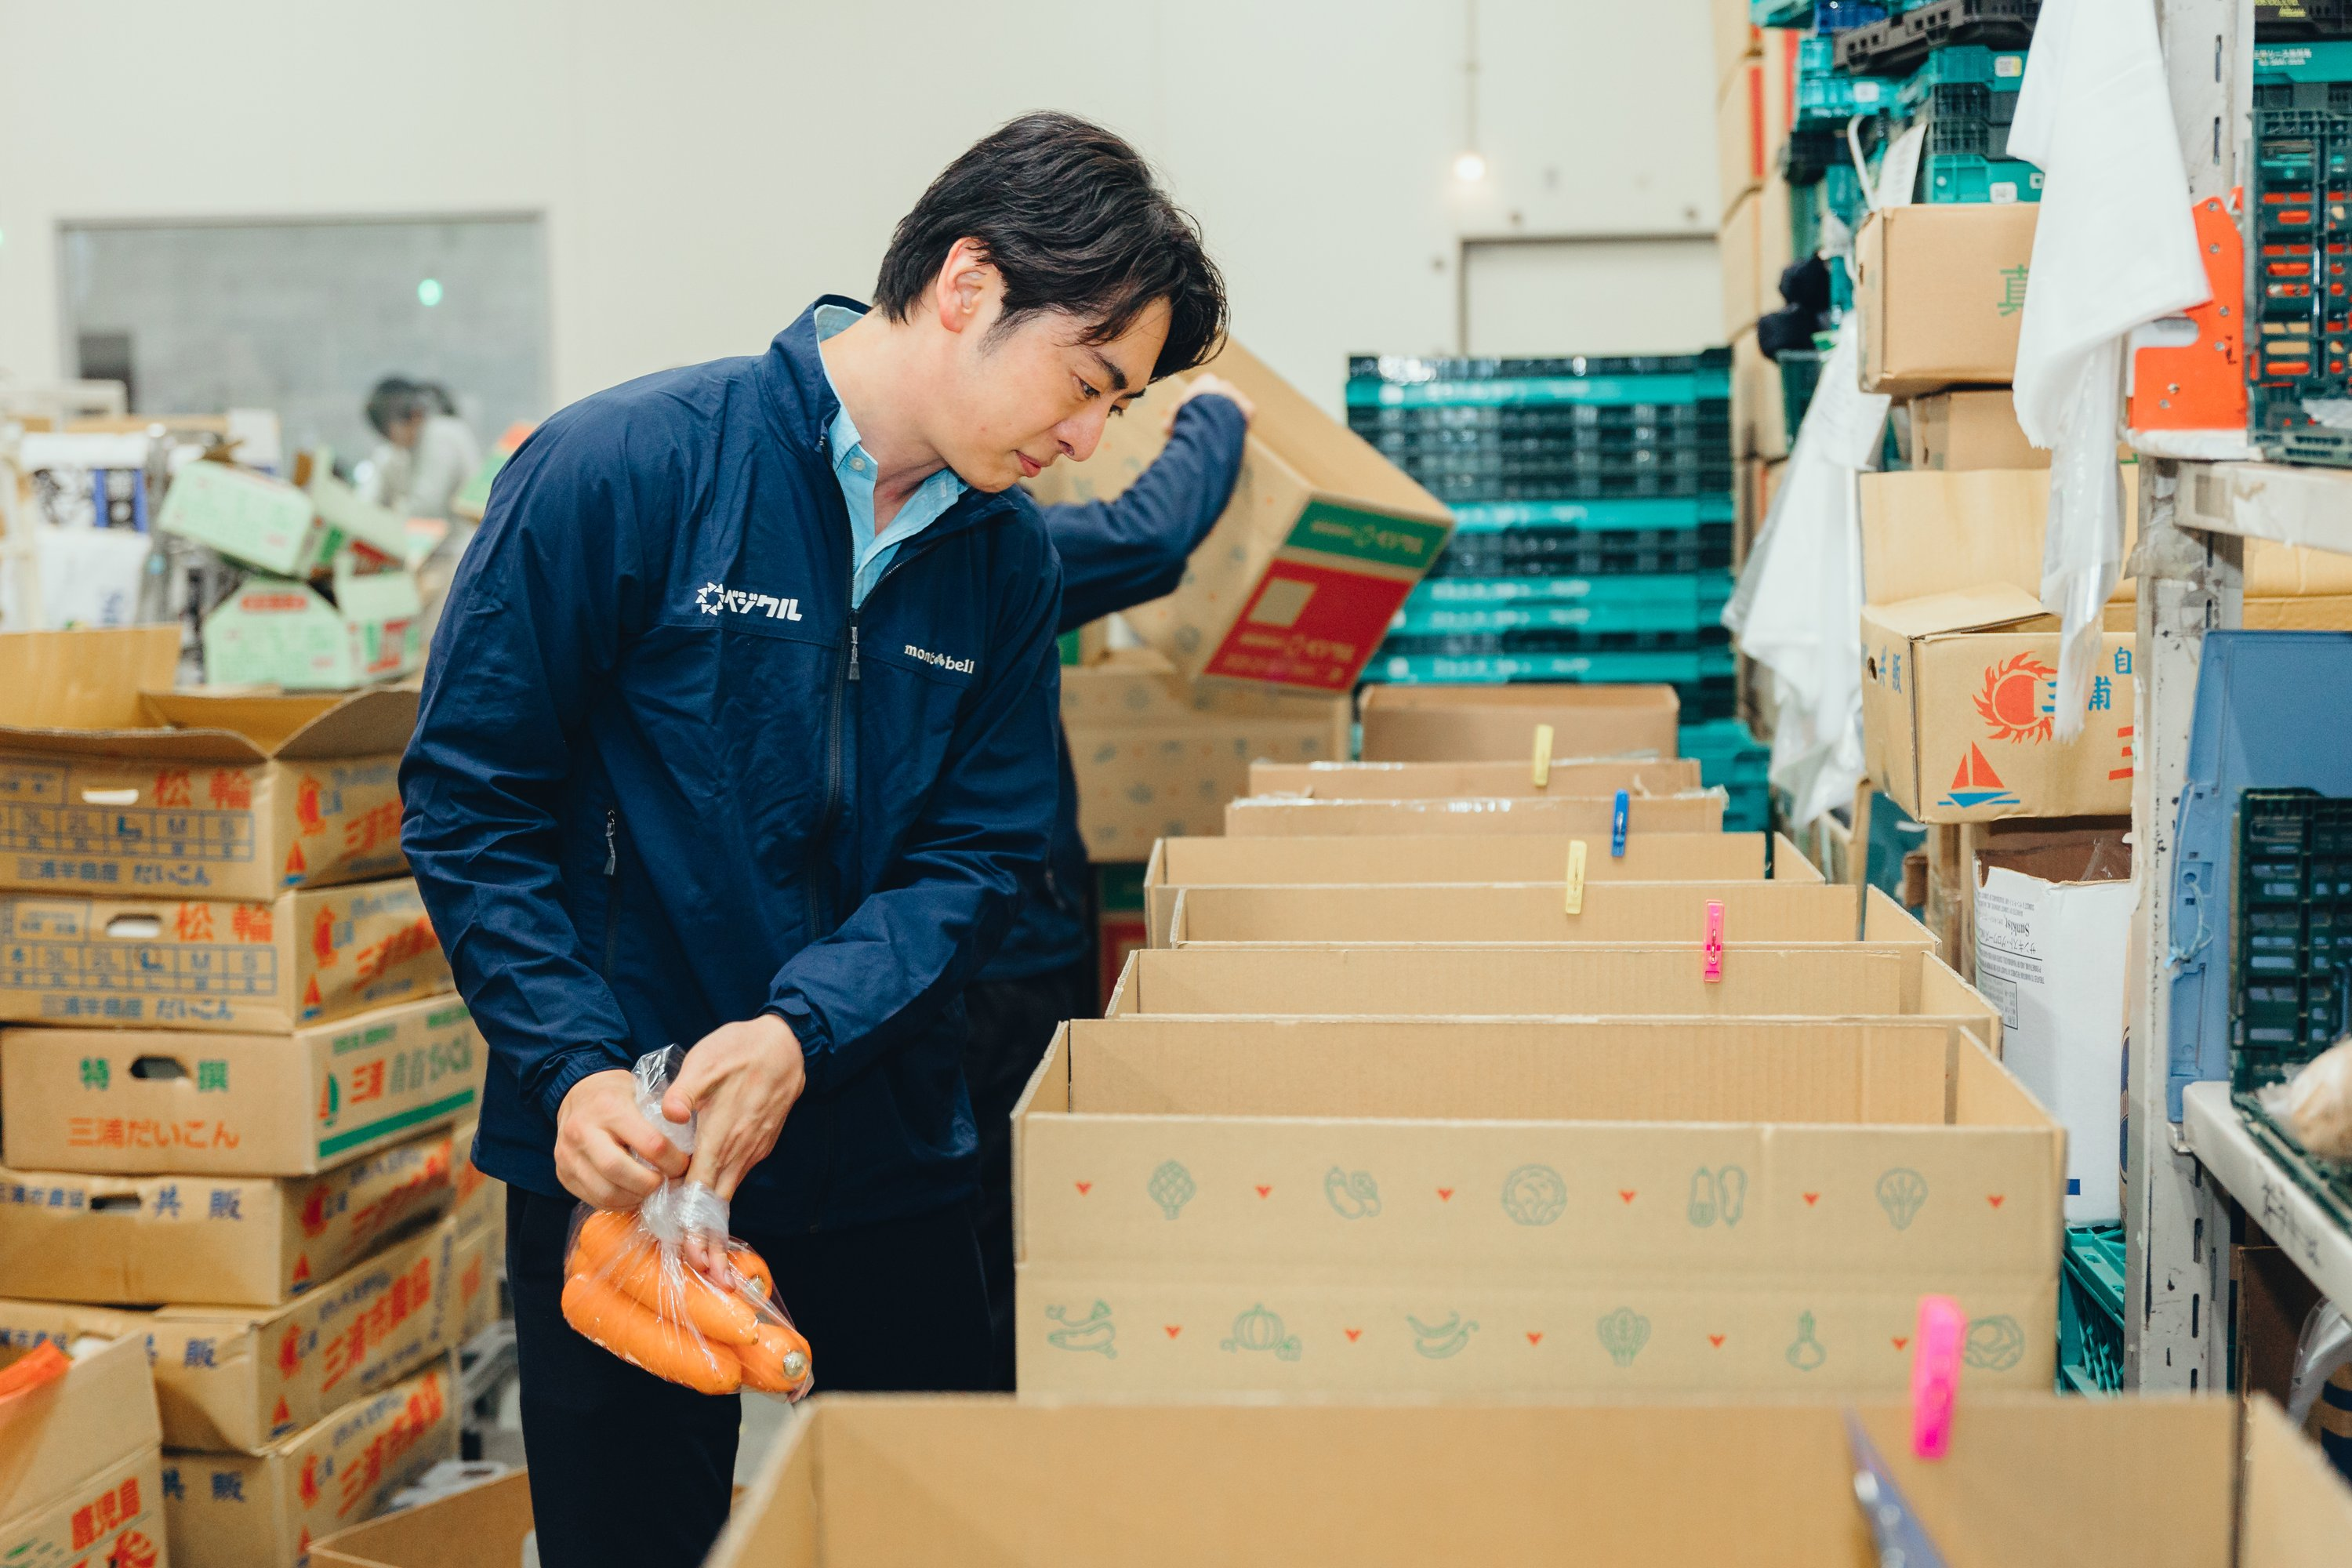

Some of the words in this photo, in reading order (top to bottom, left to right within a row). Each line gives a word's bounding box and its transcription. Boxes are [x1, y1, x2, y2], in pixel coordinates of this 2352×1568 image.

[724, 590, 802, 622] ベジクル
[2005, 918, 2030, 937] Sunkist
